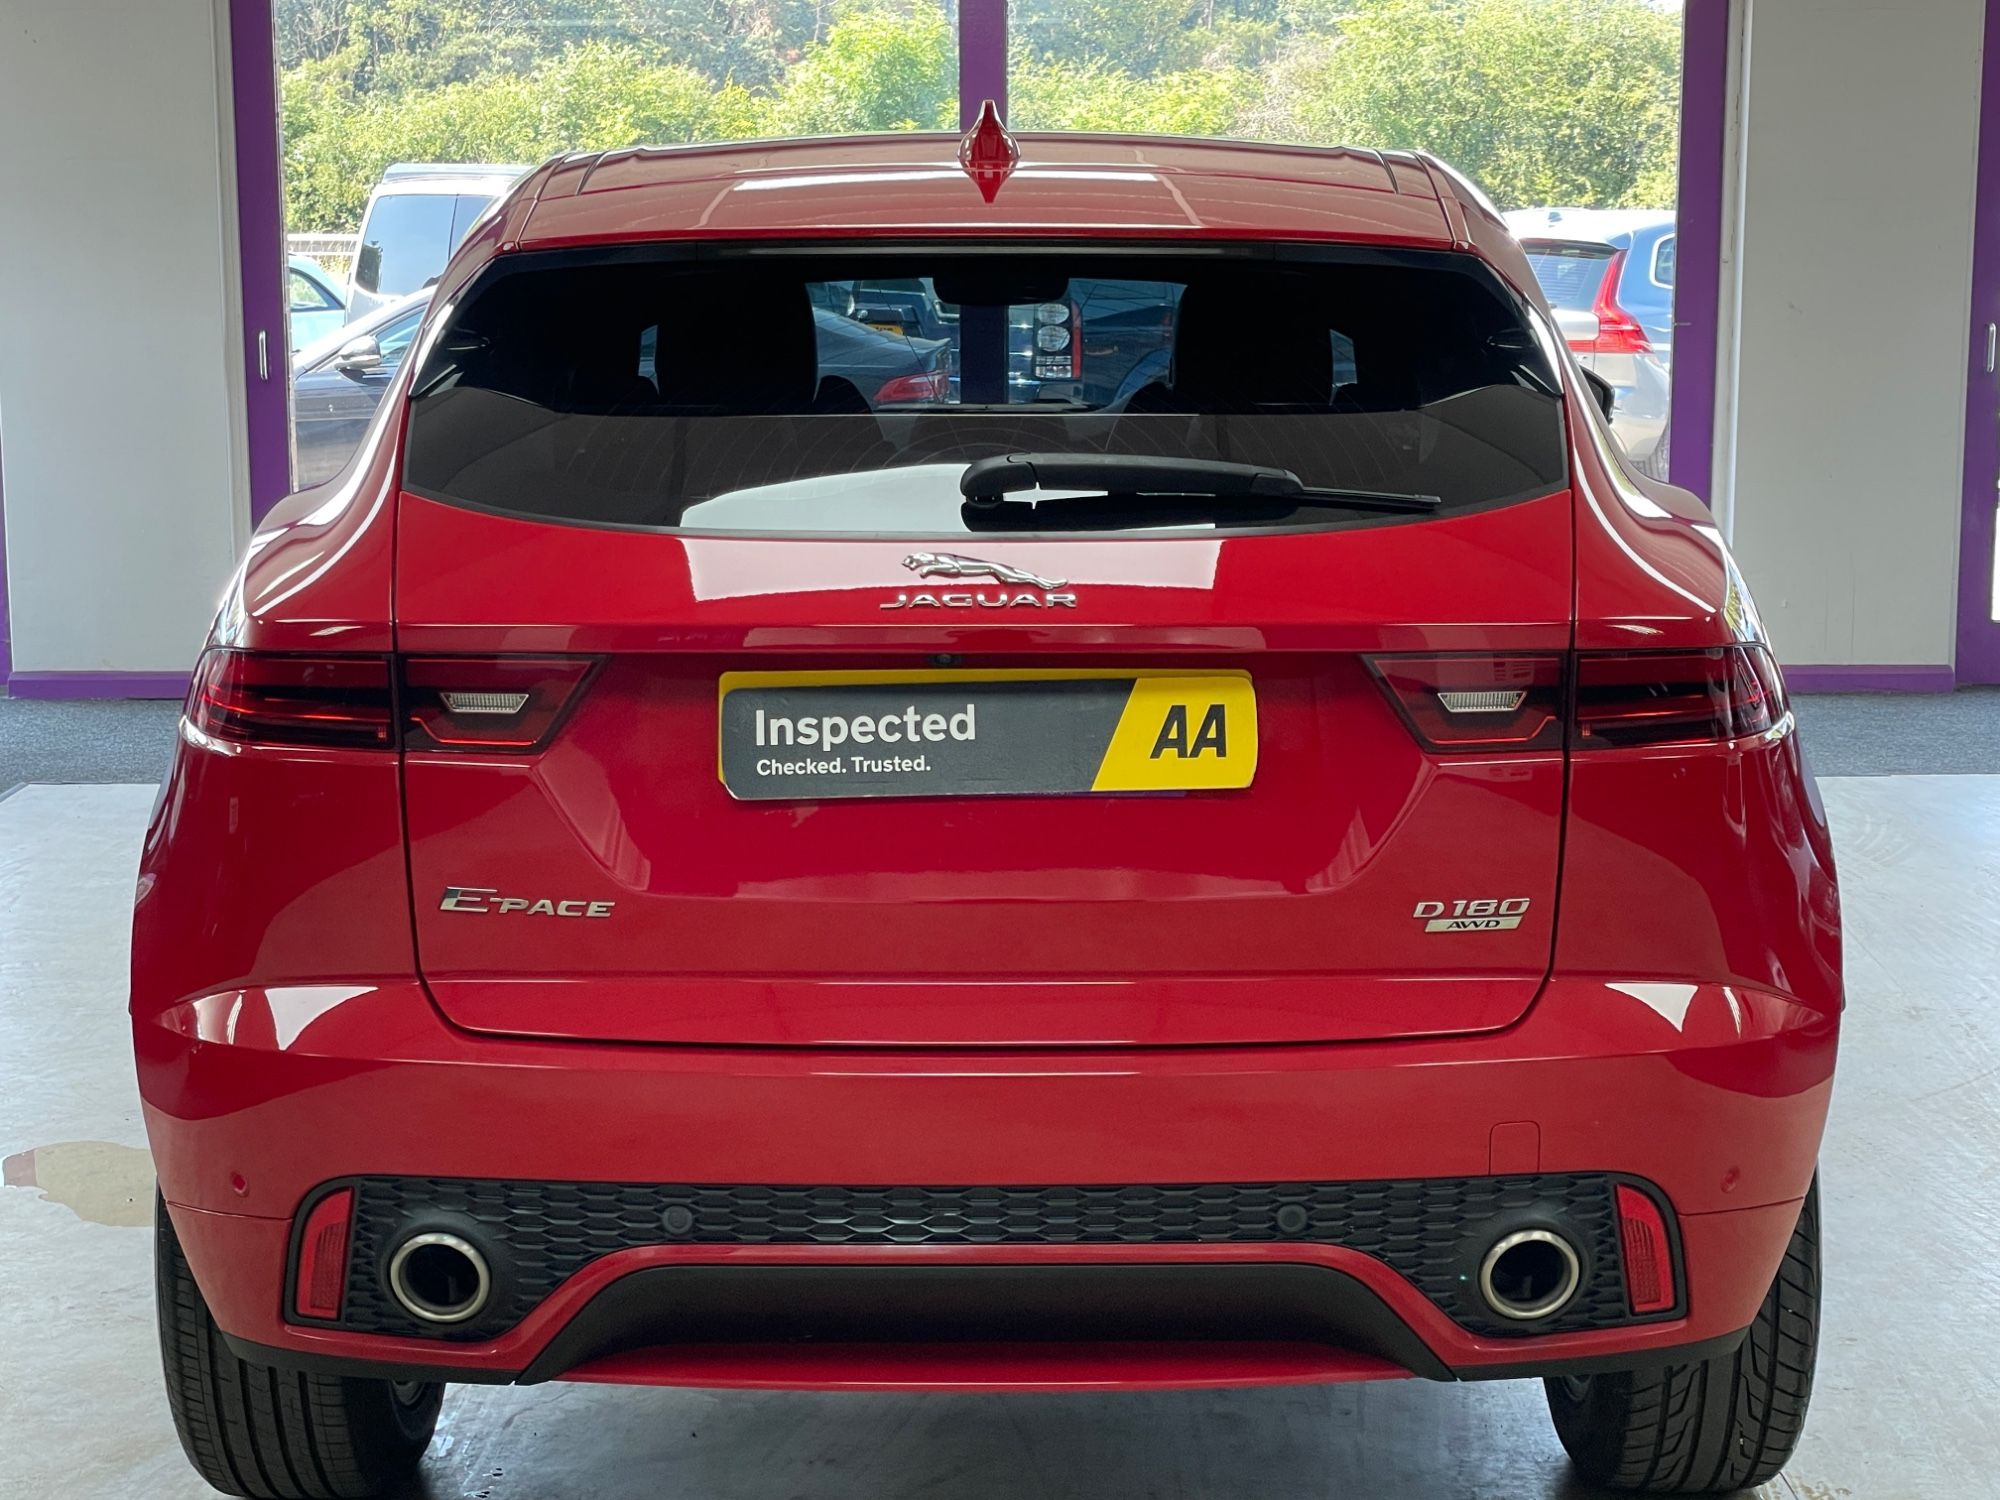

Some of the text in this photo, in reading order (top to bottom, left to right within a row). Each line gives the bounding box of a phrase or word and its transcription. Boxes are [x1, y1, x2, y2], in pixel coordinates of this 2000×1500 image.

[879, 593, 1077, 608] JAGUAR
[755, 703, 976, 752] Inspected
[1149, 703, 1227, 759] AA
[756, 755, 931, 776] Checked. Trusted.
[1447, 919, 1500, 929] AWD
